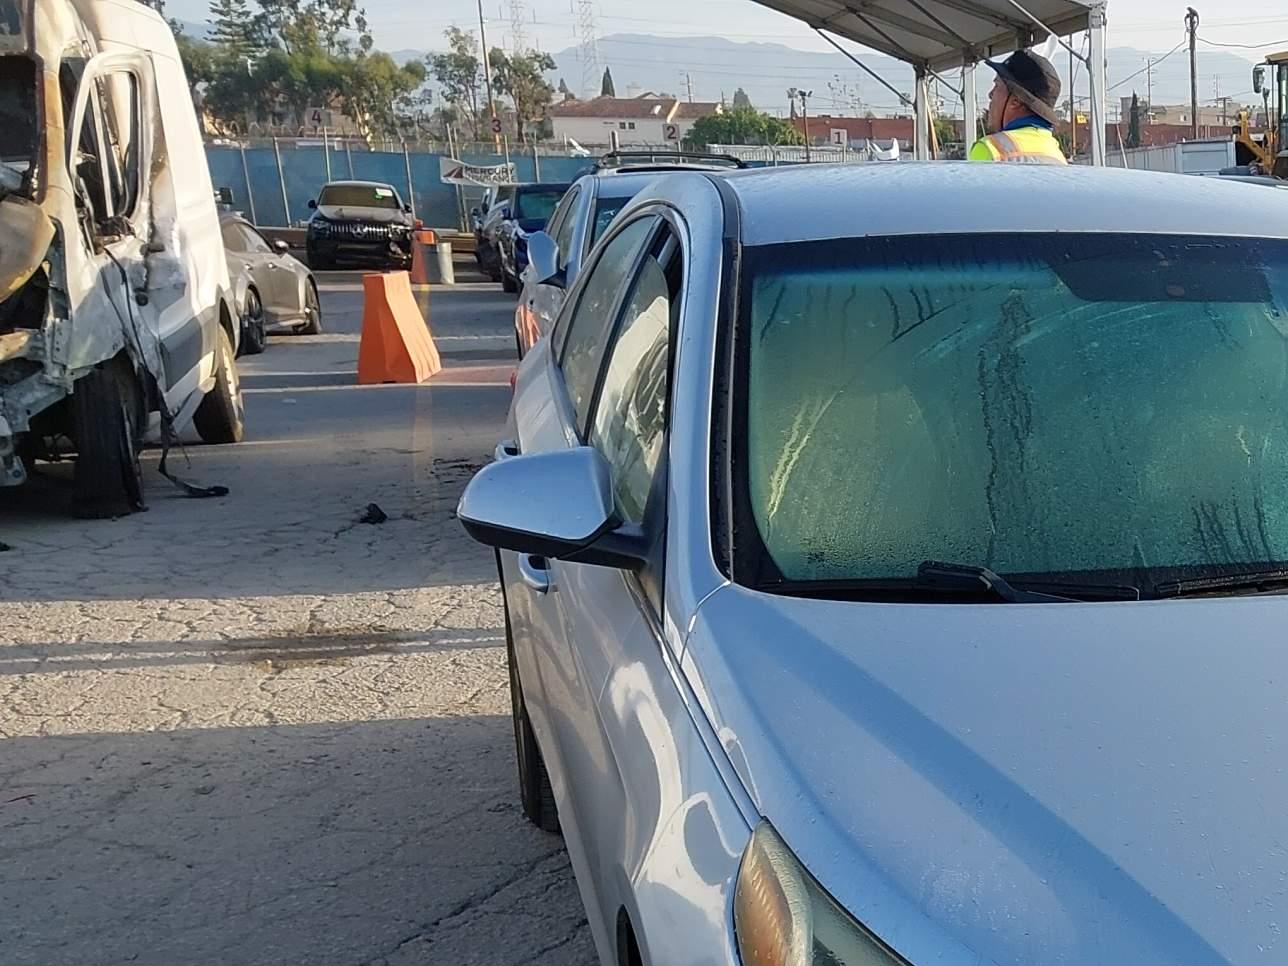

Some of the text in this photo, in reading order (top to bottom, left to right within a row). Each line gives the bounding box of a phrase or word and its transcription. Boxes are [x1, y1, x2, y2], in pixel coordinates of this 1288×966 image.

[311, 110, 322, 124] 4
[491, 119, 502, 133] 3
[666, 125, 677, 139] 2
[834, 131, 844, 145] 1
